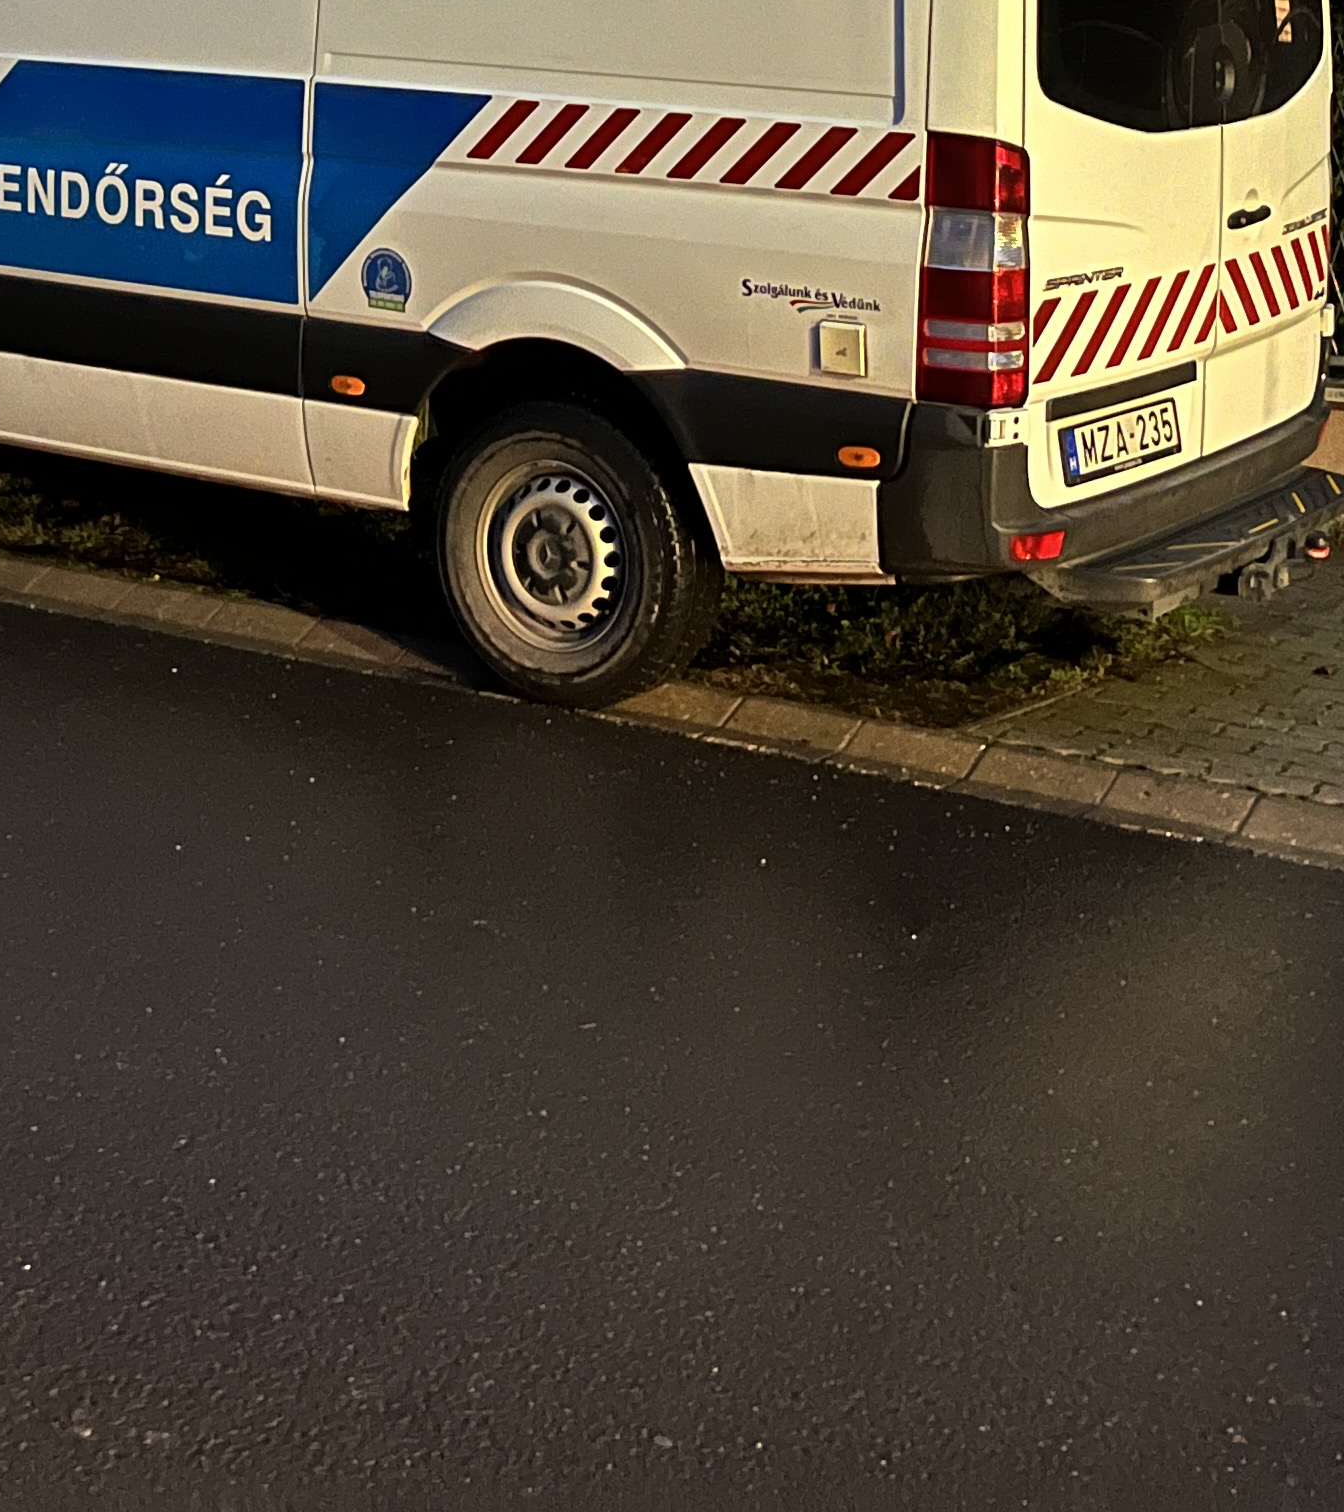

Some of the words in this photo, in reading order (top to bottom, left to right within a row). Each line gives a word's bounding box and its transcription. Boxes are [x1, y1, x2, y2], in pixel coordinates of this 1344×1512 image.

[741, 278, 812, 299] Szolgálunk
[814, 287, 829, 301] és
[1081, 406, 1174, 468] MZA-235
